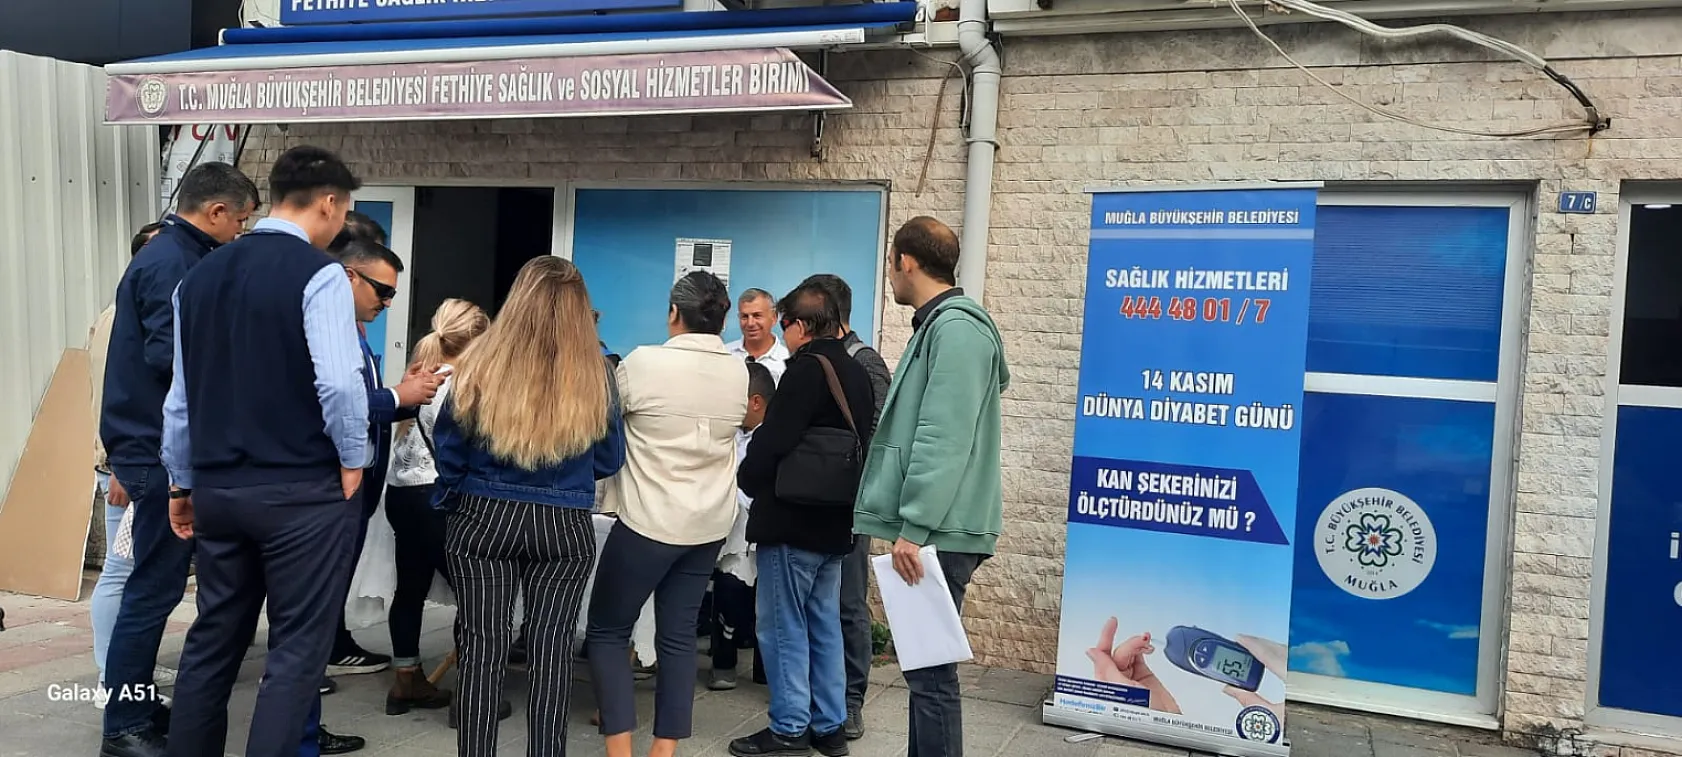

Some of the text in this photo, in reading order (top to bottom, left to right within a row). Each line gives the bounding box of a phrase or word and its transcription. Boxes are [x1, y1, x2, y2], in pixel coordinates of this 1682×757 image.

[179, 84, 203, 110] T.C.
[207, 78, 252, 110] MUĞLA
[256, 73, 342, 116] BÜYÜKŞEHİR
[347, 69, 428, 107] BELEDİYESİ
[431, 66, 493, 104] FETHİYE
[499, 65, 554, 101] SAĞLIK
[558, 77, 576, 100] ve
[580, 68, 640, 101] SOSYAL
[645, 60, 744, 98] HİZMETLER
[1567, 195, 1577, 209] 7
[1105, 208, 1299, 226] MUĞLA BÜYÜKŞEHİR BELEDİYESİ
[1106, 265, 1288, 291] SAĞLIK HİZMETLERİ
[1120, 296, 1161, 319] 444
[1168, 297, 1196, 320] 48
[1203, 297, 1230, 322] 01
[1254, 299, 1271, 323] 7
[1141, 369, 1235, 395] 14 KASIM
[1083, 393, 1295, 431] DÜNYA DİYABET GÜNÜ
[1096, 468, 1238, 501] KAN ŞEKERİNİZİ
[1076, 491, 1257, 533] ÖLÇTÜRDÜNÜZ MÜ ?
[1325, 496, 1426, 565] T.C. BÜYÜKŞEHİR BELEDİYESİ
[1344, 574, 1399, 593] MUĞLA
